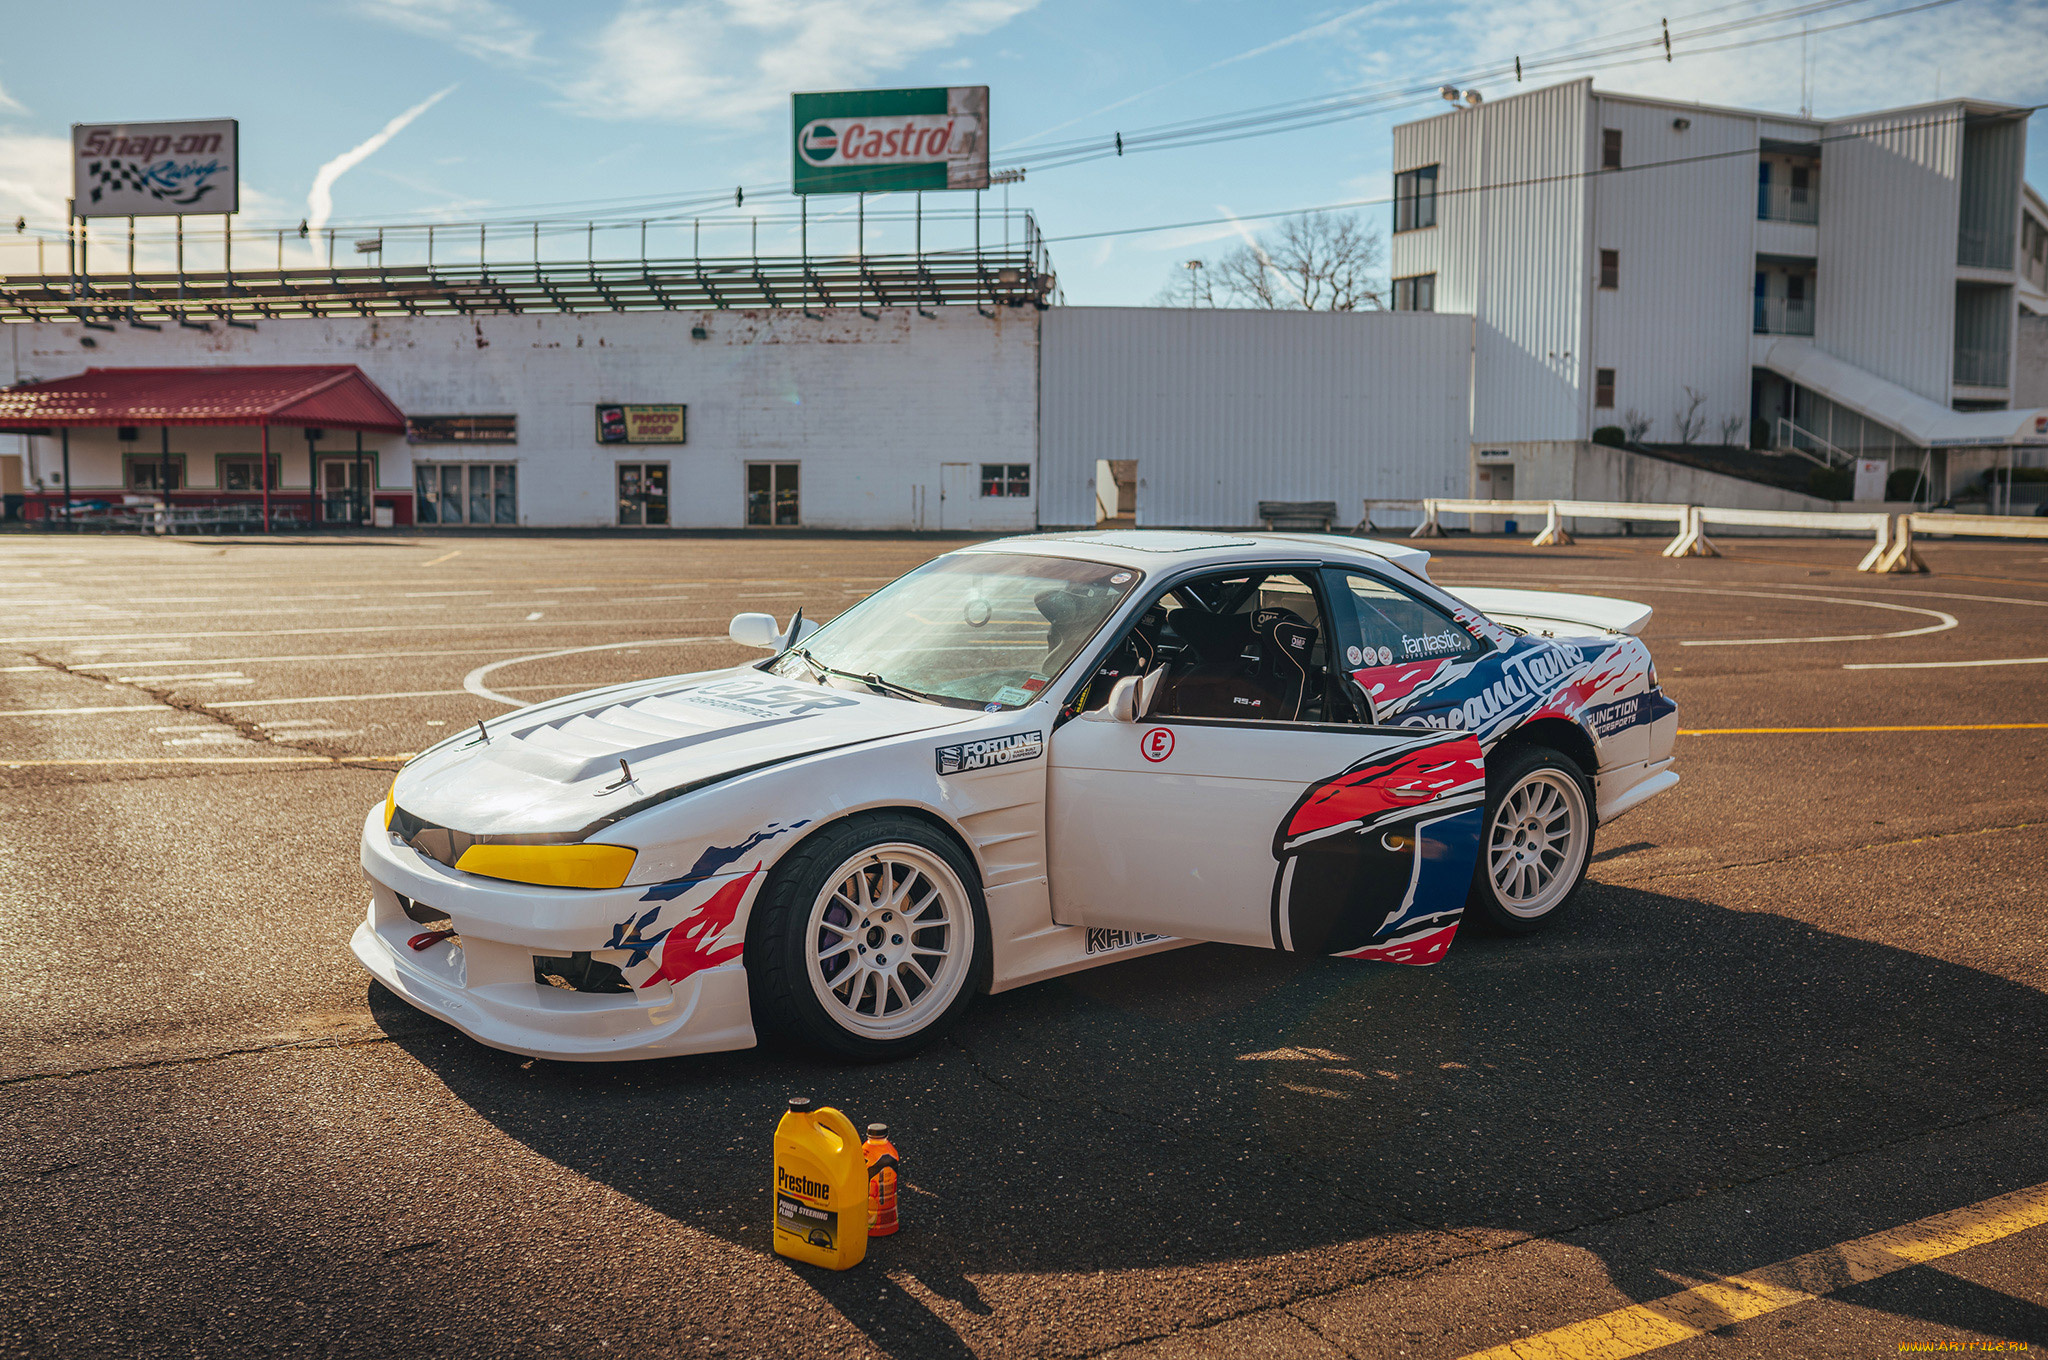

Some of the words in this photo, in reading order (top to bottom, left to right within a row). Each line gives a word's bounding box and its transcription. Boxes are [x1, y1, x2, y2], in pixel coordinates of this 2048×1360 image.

[81, 130, 223, 163] Snap-on
[140, 159, 229, 187] Racing
[632, 414, 679, 424] PHOTO
[1401, 651, 1432, 660] voyages
[1435, 645, 1471, 655] unlimited
[1402, 630, 1461, 653] fantastic
[1586, 698, 1638, 726] FUNCTION
[964, 732, 1041, 757] FORTUNE
[965, 750, 1010, 770] AUTO
[778, 1165, 830, 1200] Prestone
[778, 1207, 794, 1219] FLUID
[779, 1199, 799, 1213] POWER
[798, 1206, 829, 1221] STEERING
